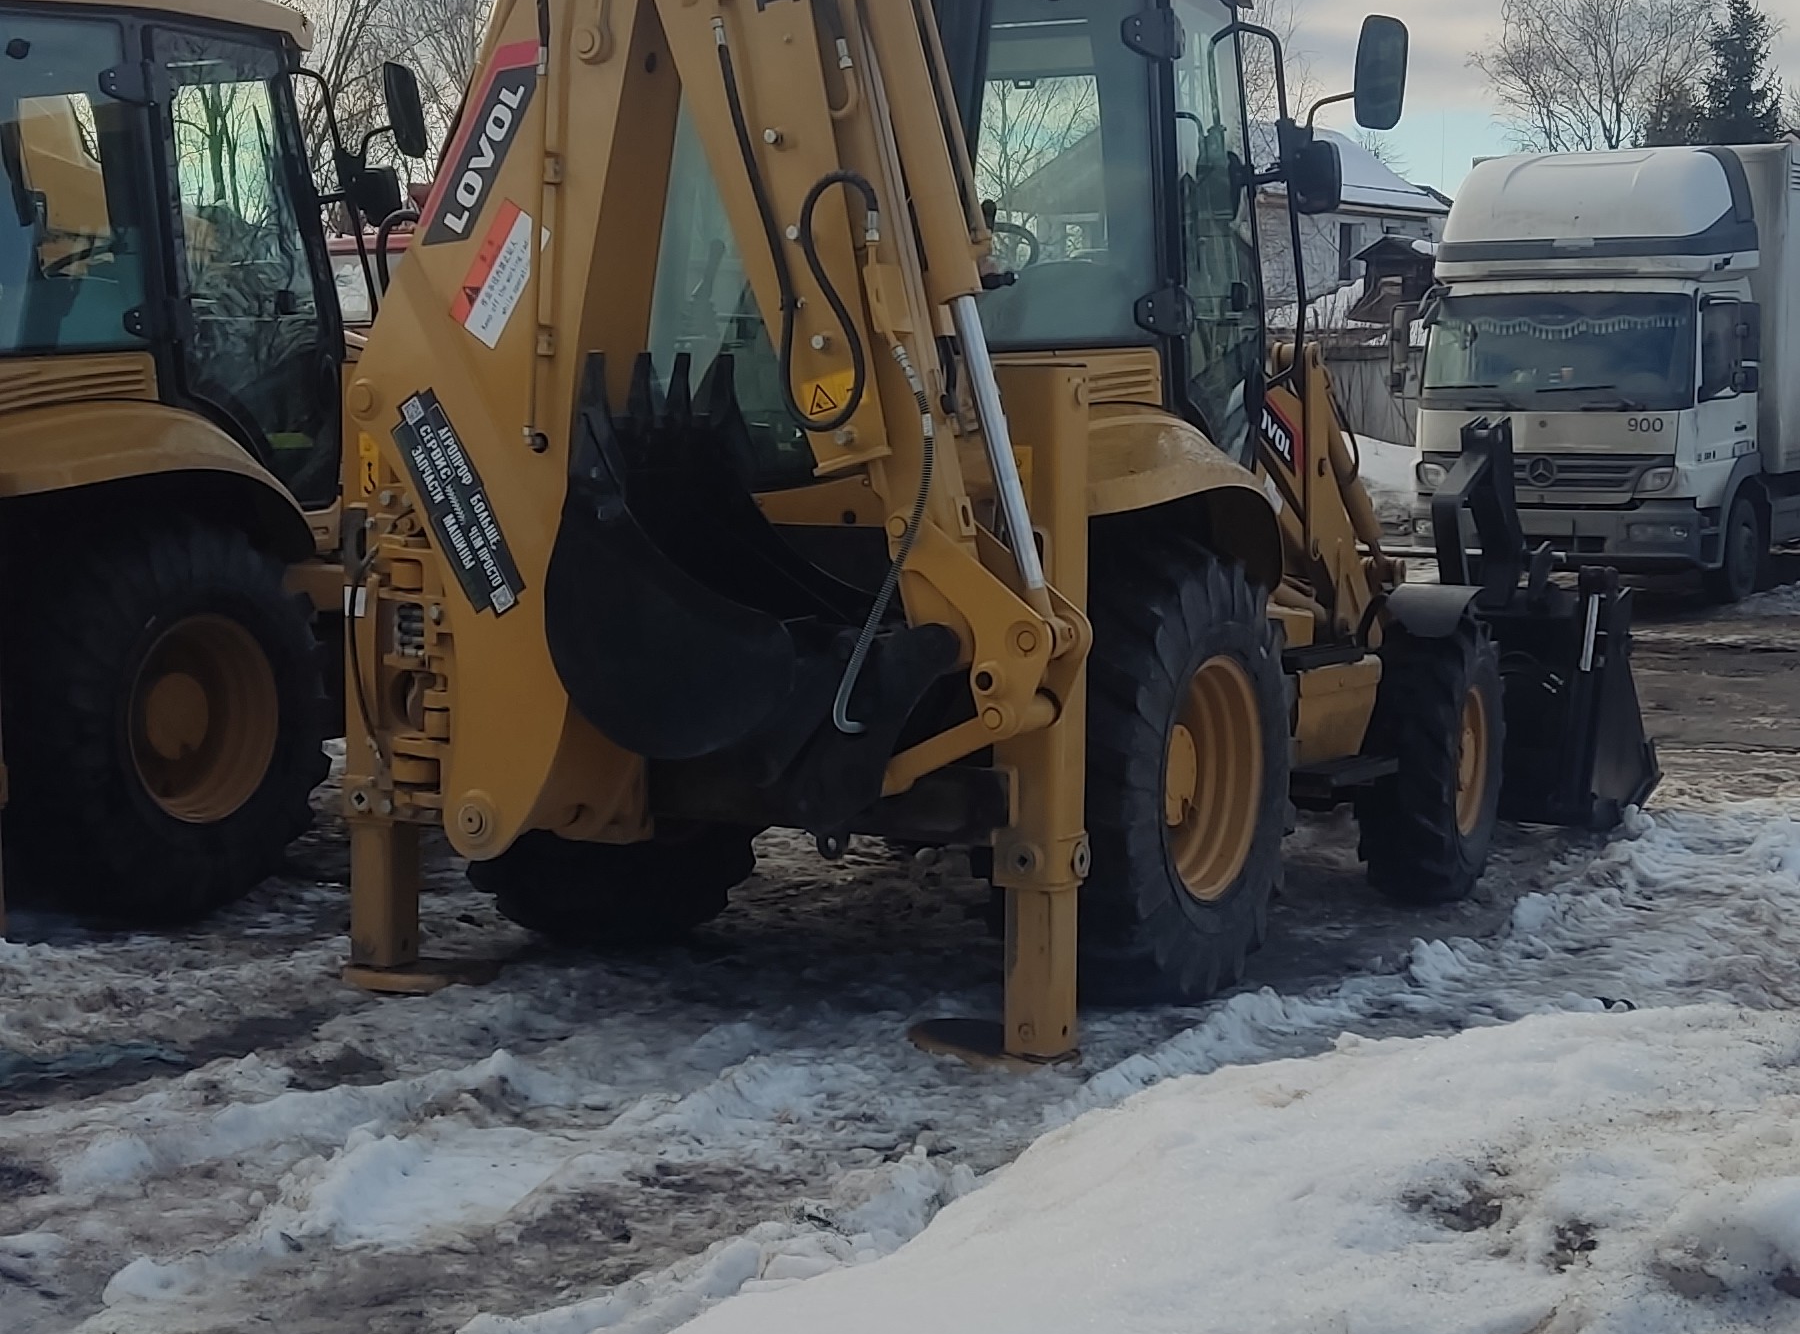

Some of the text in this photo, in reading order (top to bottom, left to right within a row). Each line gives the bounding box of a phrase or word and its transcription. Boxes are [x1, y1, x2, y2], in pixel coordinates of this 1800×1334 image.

[443, 85, 525, 234] LOVOL
[419, 424, 452, 480] СЕРВИС
[1261, 408, 1291, 462] VOL
[1627, 417, 1664, 433] 900
[411, 445, 445, 504] ЗАПЧАСТИ
[438, 426, 474, 486] АГРОПРОФ
[442, 512, 477, 570] МАШИНЫ
[469, 494, 502, 551] БОЛЬШЕ,
[468, 525, 503, 587] ЧЕМ ПРОСТО
